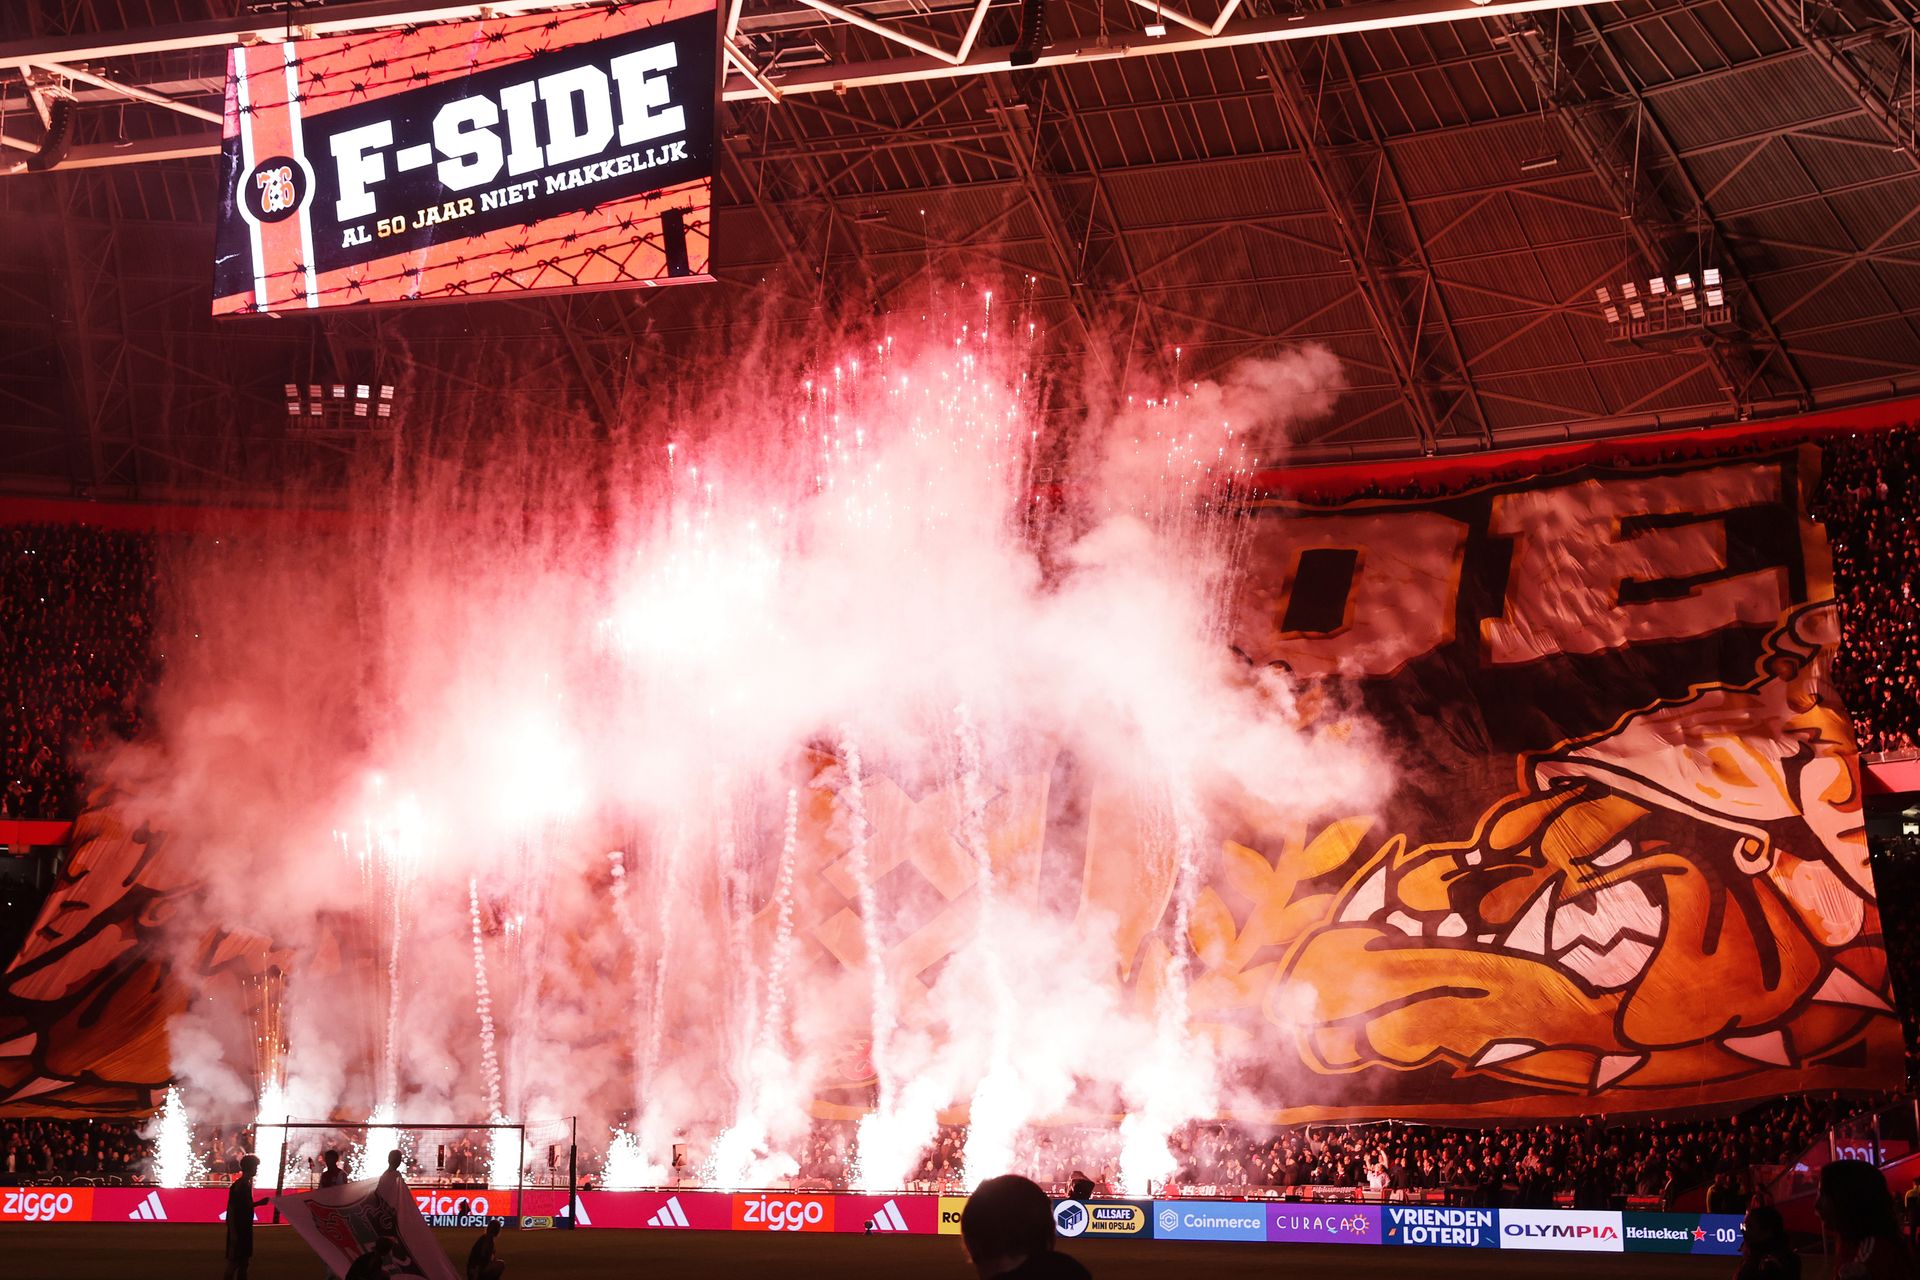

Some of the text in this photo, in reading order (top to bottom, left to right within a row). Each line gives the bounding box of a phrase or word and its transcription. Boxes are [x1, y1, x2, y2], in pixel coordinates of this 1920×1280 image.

[329, 42, 687, 222] F-SIDE
[341, 140, 688, 248] AL 50 JAAR NIET MAKKELIJK
[3, 1187, 73, 1222] ziggo
[743, 1194, 824, 1231] ziggo
[433, 1215, 458, 1227] MINI
[460, 1215, 505, 1228] OPSLG
[1096, 1209, 1131, 1219] ALLSAFE
[1183, 1213, 1261, 1229] Coinmerce
[1389, 1208, 1493, 1228] VRIENDEN
[1092, 1221, 1136, 1231] MINI OPSLAG
[1504, 1224, 1618, 1241] OLYMPIA
[1626, 1226, 1689, 1240] Heineken
[1403, 1226, 1480, 1246] LOTERIJ
